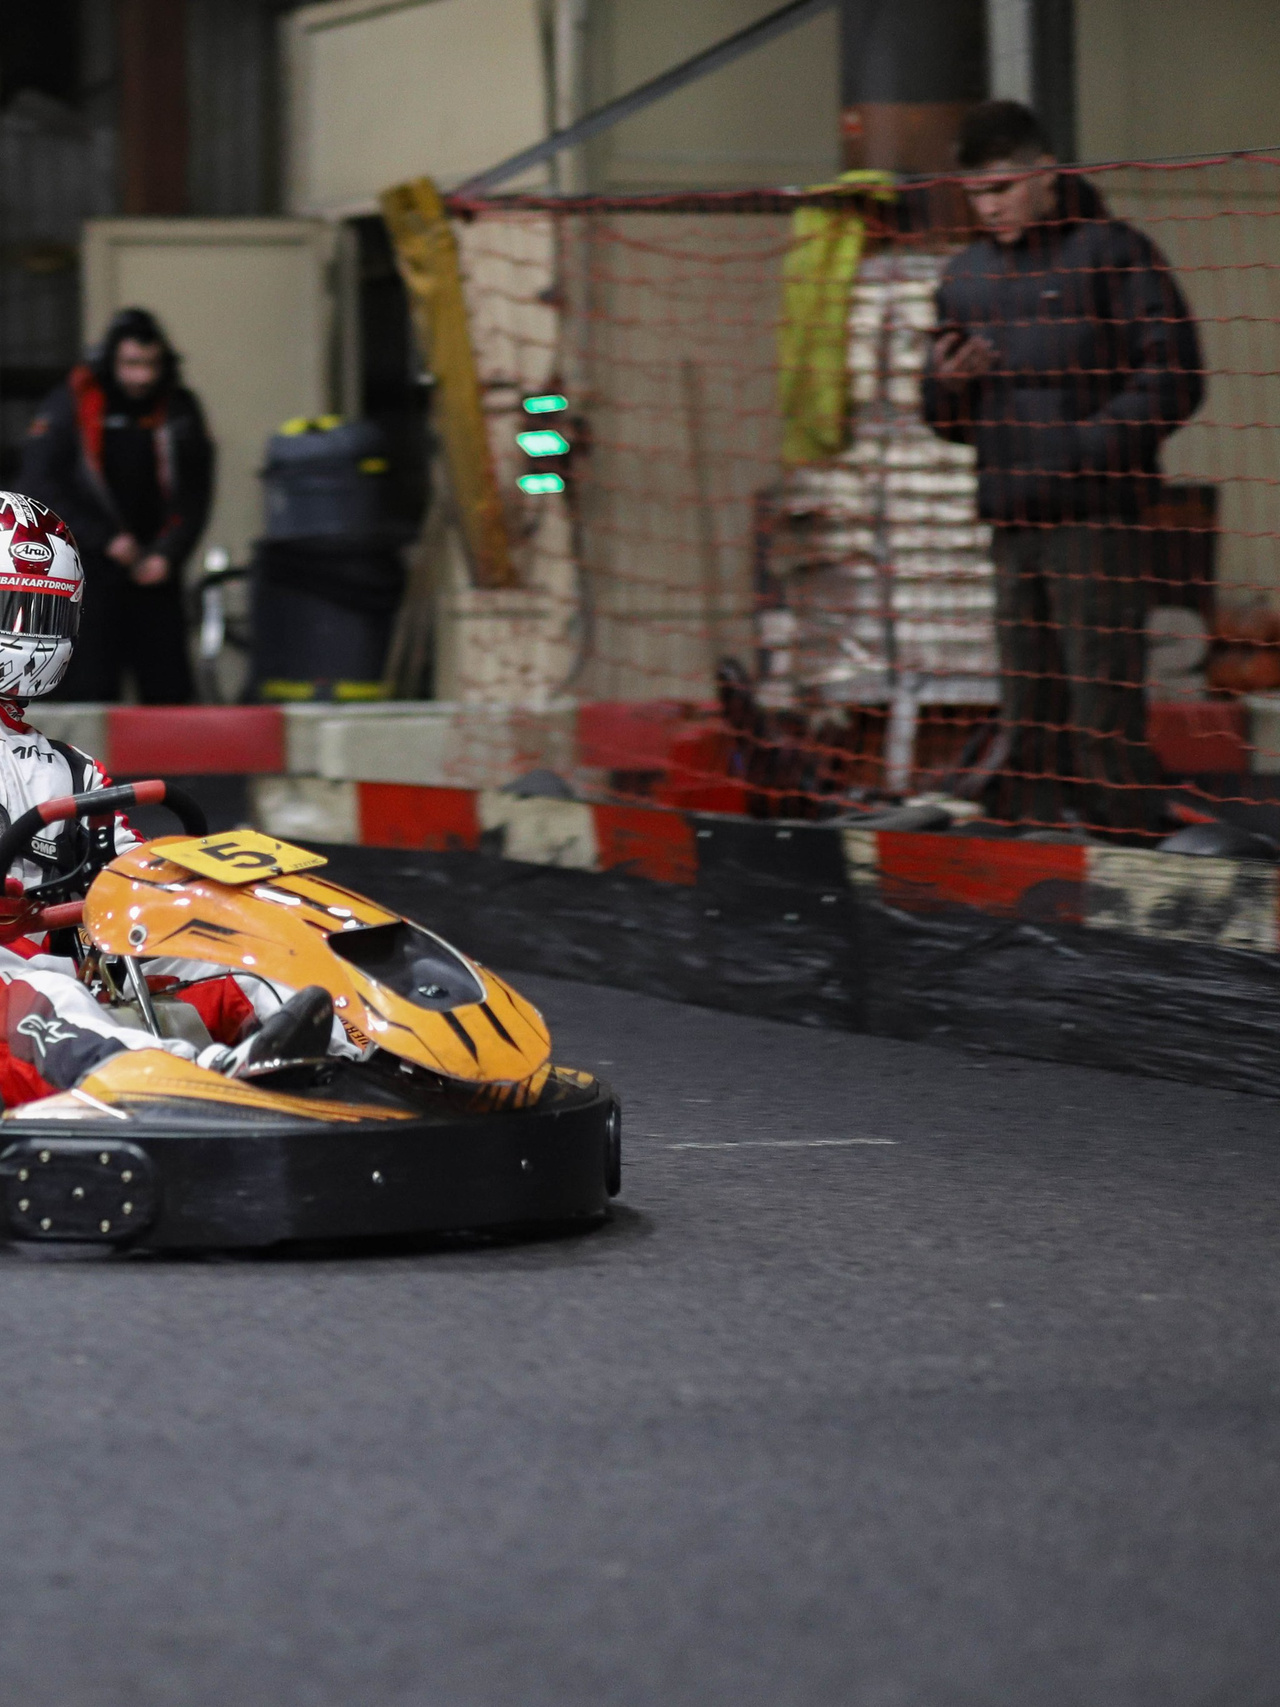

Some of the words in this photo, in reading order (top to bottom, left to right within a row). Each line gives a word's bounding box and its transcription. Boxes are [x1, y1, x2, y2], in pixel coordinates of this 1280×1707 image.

[16, 544, 46, 557] Arai
[21, 577, 76, 593] KARTDROME
[31, 839, 57, 855] OMP
[198, 842, 277, 869] 5
